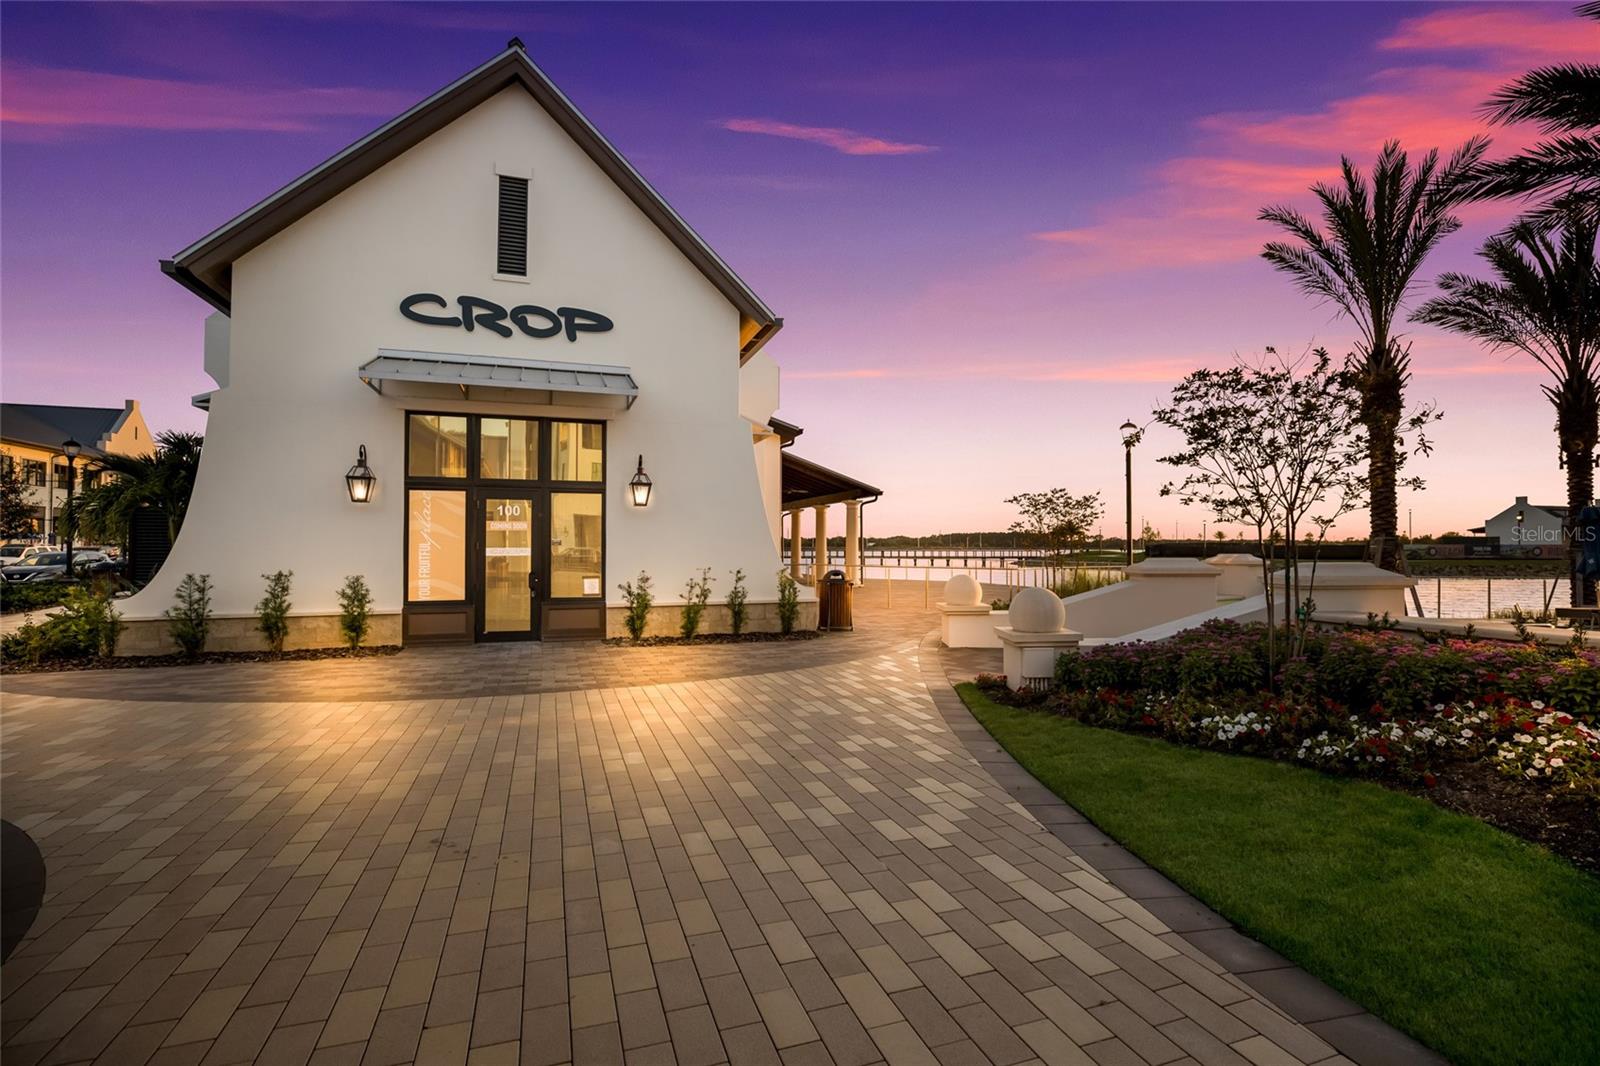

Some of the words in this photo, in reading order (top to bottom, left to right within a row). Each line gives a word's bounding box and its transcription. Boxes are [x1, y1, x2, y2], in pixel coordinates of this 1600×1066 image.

[400, 293, 614, 342] CROP
[496, 505, 520, 516] 100
[418, 543, 431, 578] FRUITFUL
[418, 579, 431, 600] YOUR
